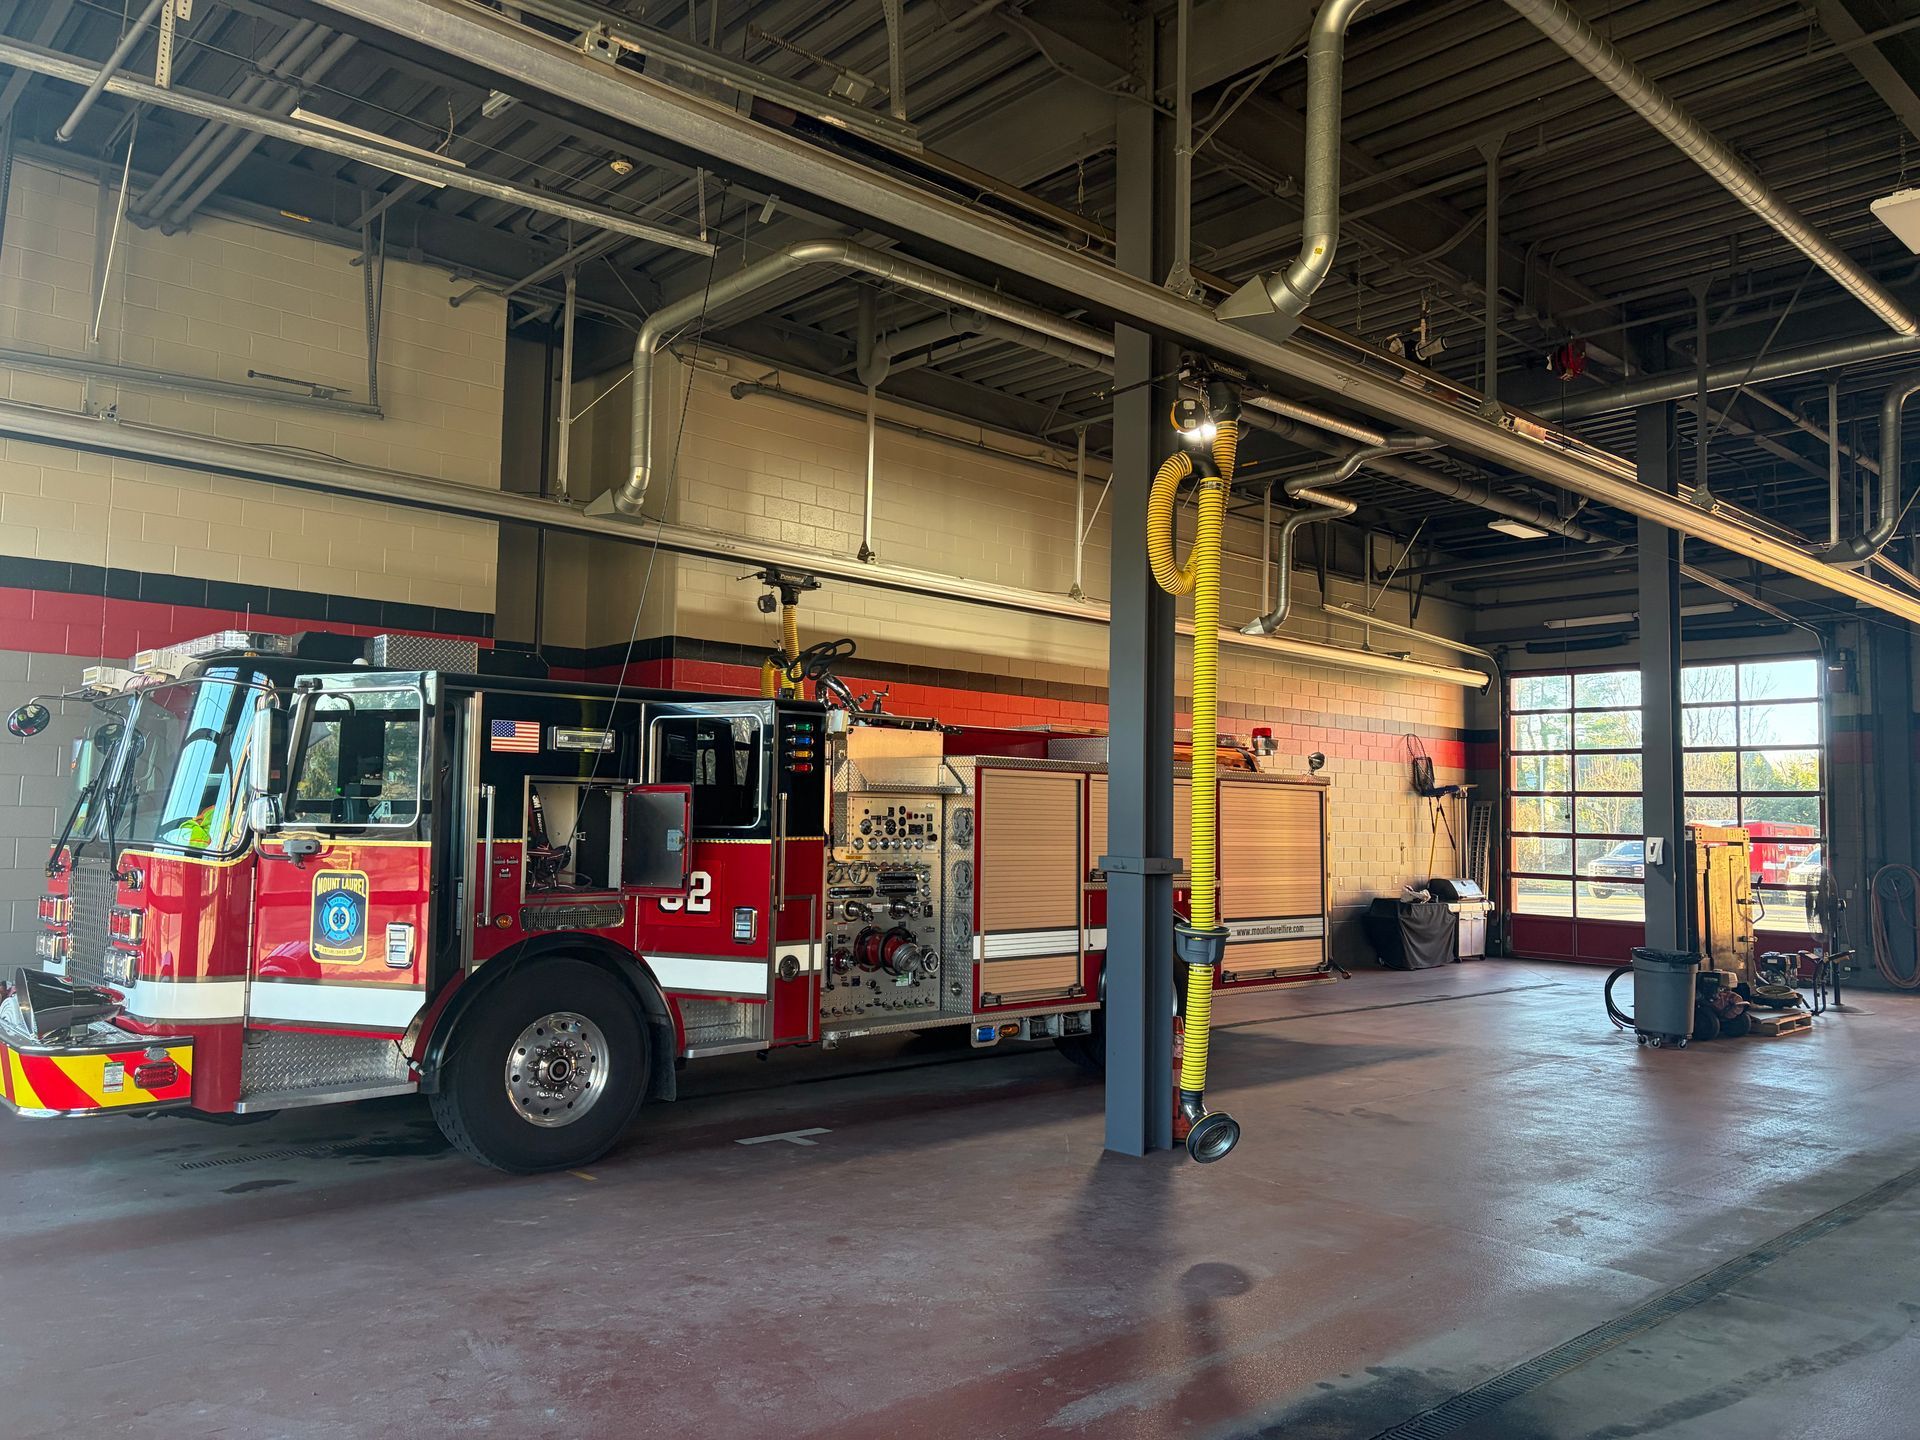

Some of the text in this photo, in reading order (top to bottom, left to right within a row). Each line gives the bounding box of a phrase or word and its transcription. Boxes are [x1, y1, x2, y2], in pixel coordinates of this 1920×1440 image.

[532, 794, 542, 808] 3M
[316, 877, 366, 898] MOUNT LAUREL
[332, 912, 346, 925] 36
[1236, 924, 1305, 936] www.mountlaurelfire.com
